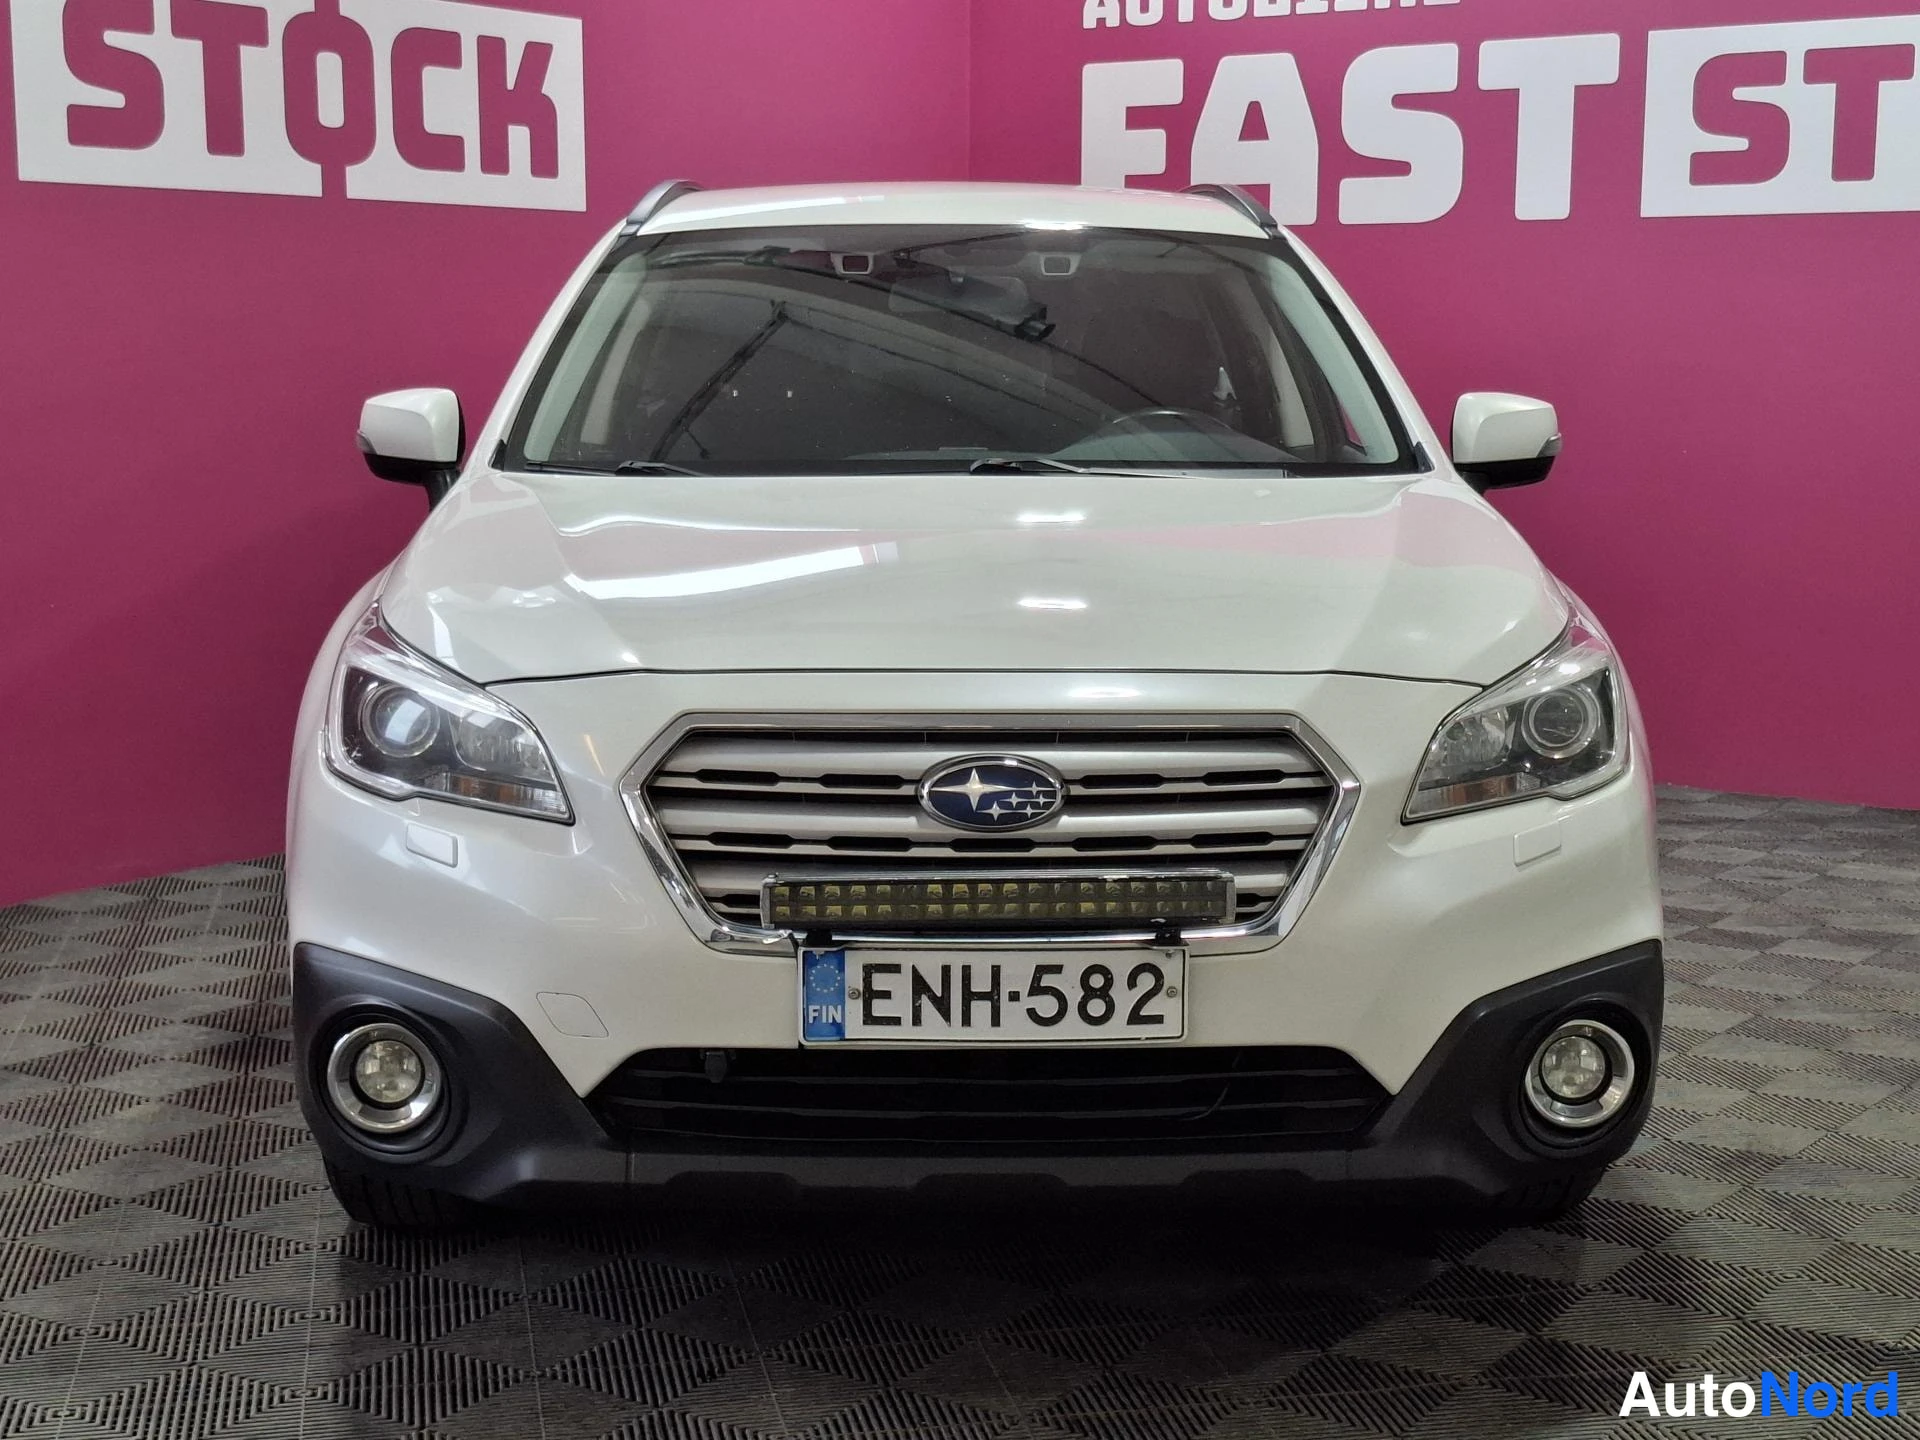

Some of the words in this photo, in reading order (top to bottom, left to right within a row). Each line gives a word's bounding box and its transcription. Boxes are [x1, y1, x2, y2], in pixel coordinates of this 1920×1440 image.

[62, 0, 559, 179] STOCK
[1080, 33, 1621, 225] FAST
[1689, 43, 1915, 187] ST
[808, 1004, 842, 1024] FIN
[861, 962, 1166, 1028] ENH-582
